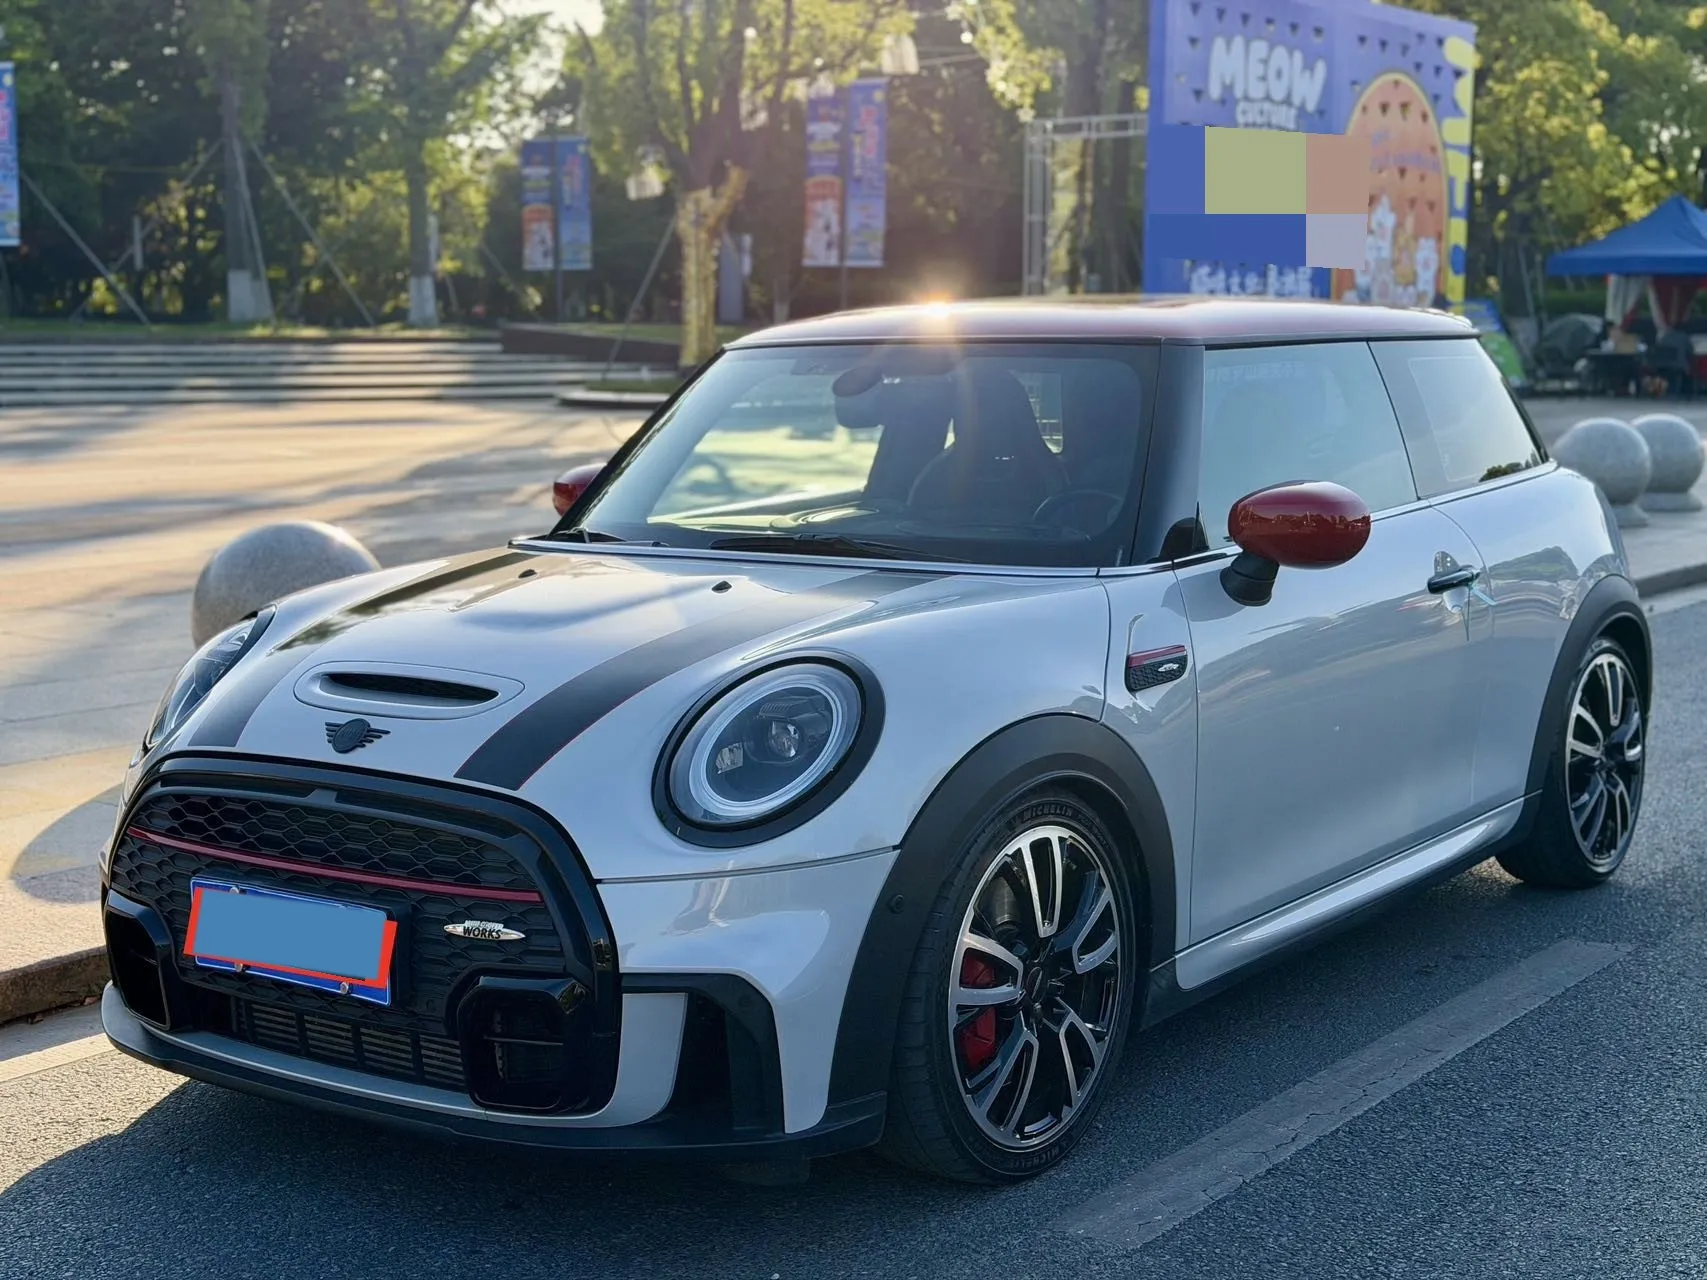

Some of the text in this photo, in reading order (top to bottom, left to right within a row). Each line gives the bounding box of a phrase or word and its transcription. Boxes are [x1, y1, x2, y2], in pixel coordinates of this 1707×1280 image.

[1208, 35, 1327, 114] MEOW
[1023, 804, 1073, 821] MICHELIN
[463, 926, 501, 939] WORKS
